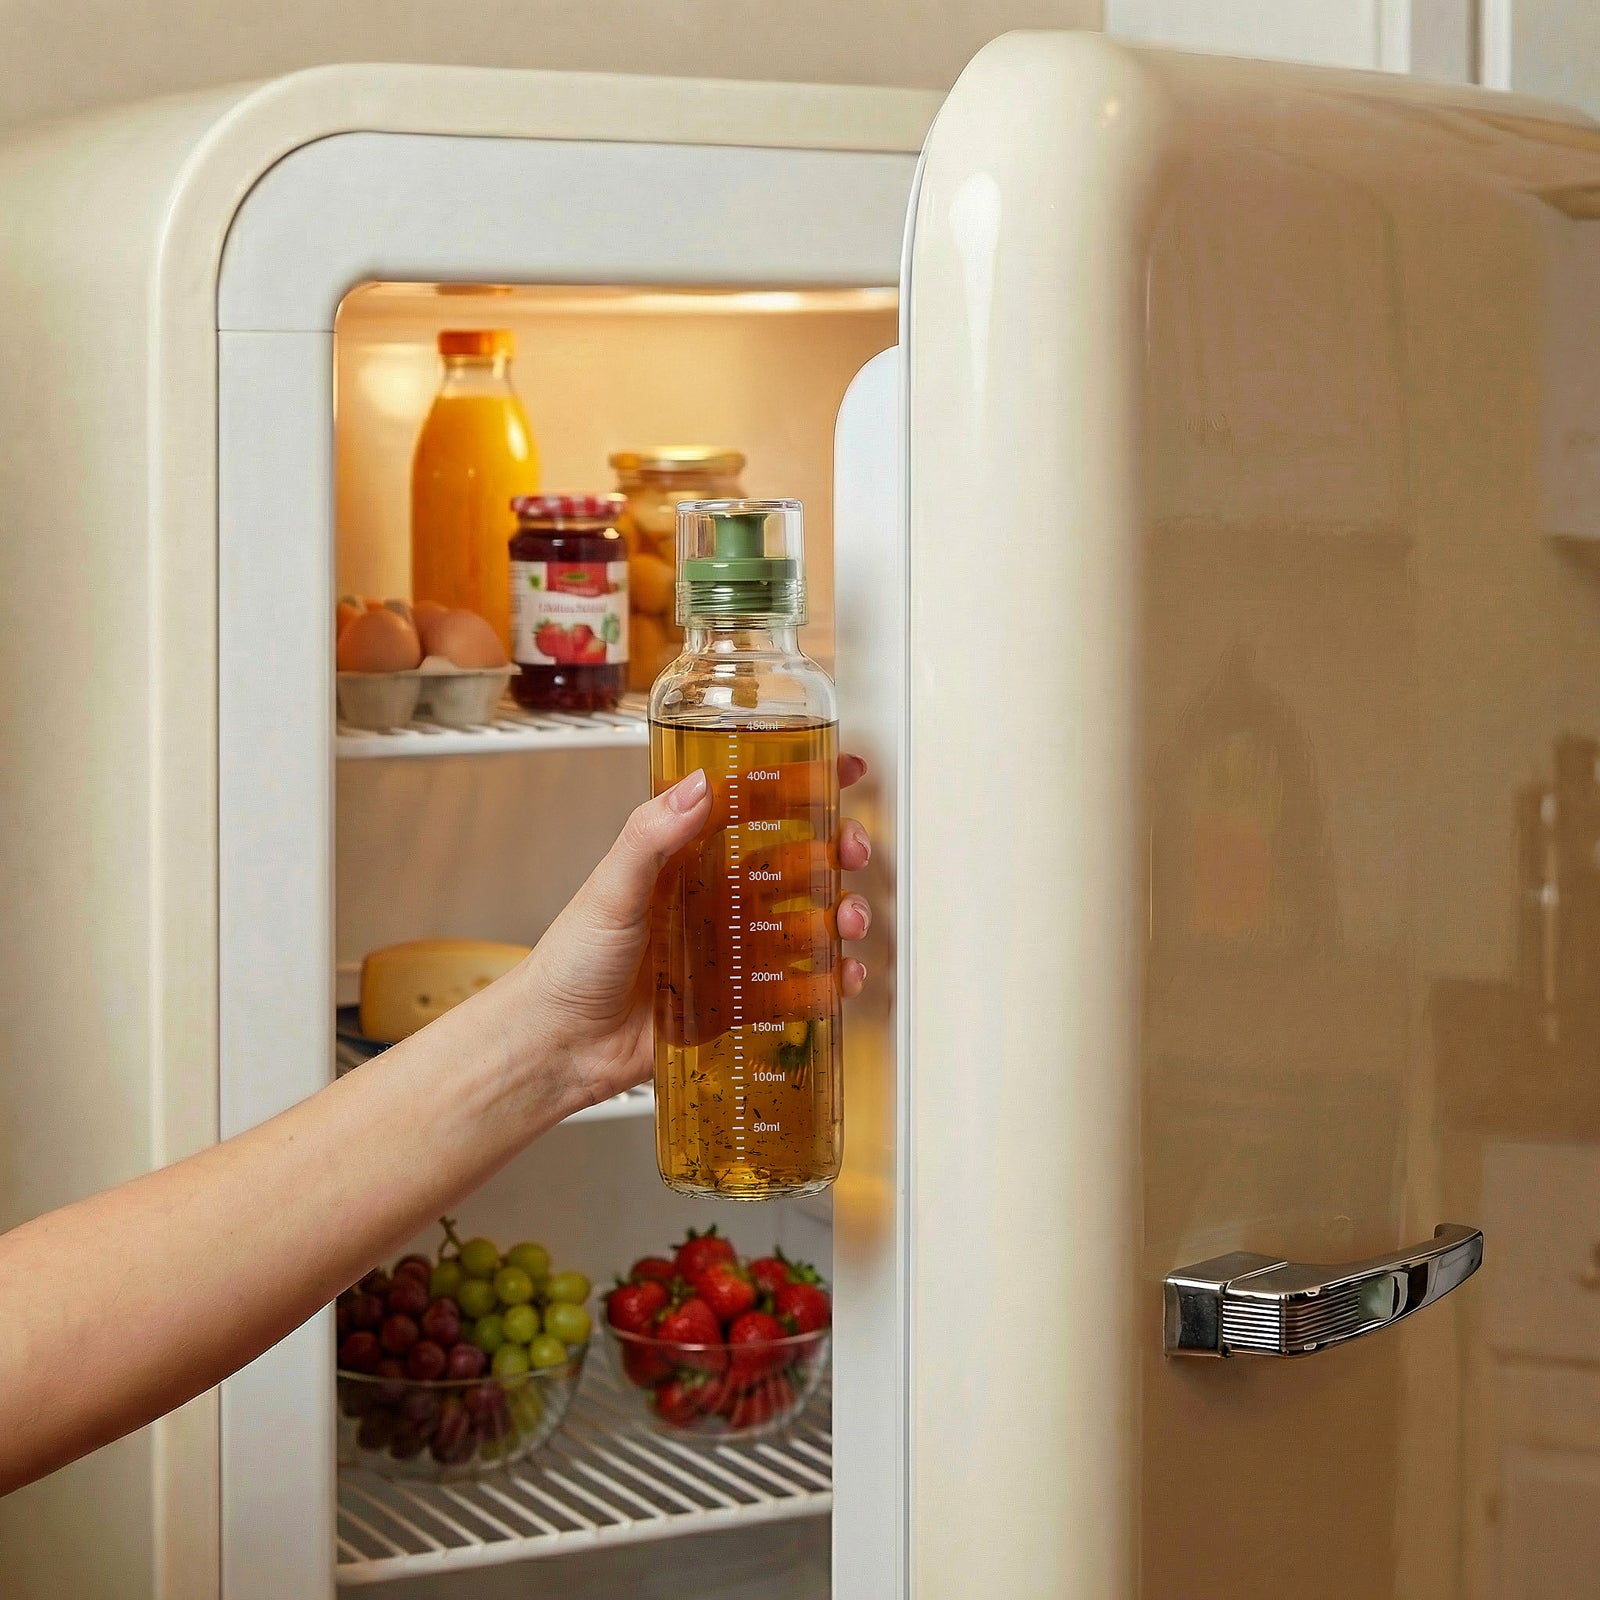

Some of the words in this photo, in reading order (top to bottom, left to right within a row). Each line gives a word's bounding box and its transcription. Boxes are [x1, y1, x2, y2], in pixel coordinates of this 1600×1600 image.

[747, 770, 780, 781] 400ml
[748, 820, 781, 831] 350ml
[748, 871, 782, 881] 300ml
[749, 921, 783, 932] 250ml
[751, 971, 783, 982] 200ml
[752, 1021, 785, 1032] 150ml
[752, 1072, 786, 1082] 100ml
[753, 1122, 780, 1132] 50ml
